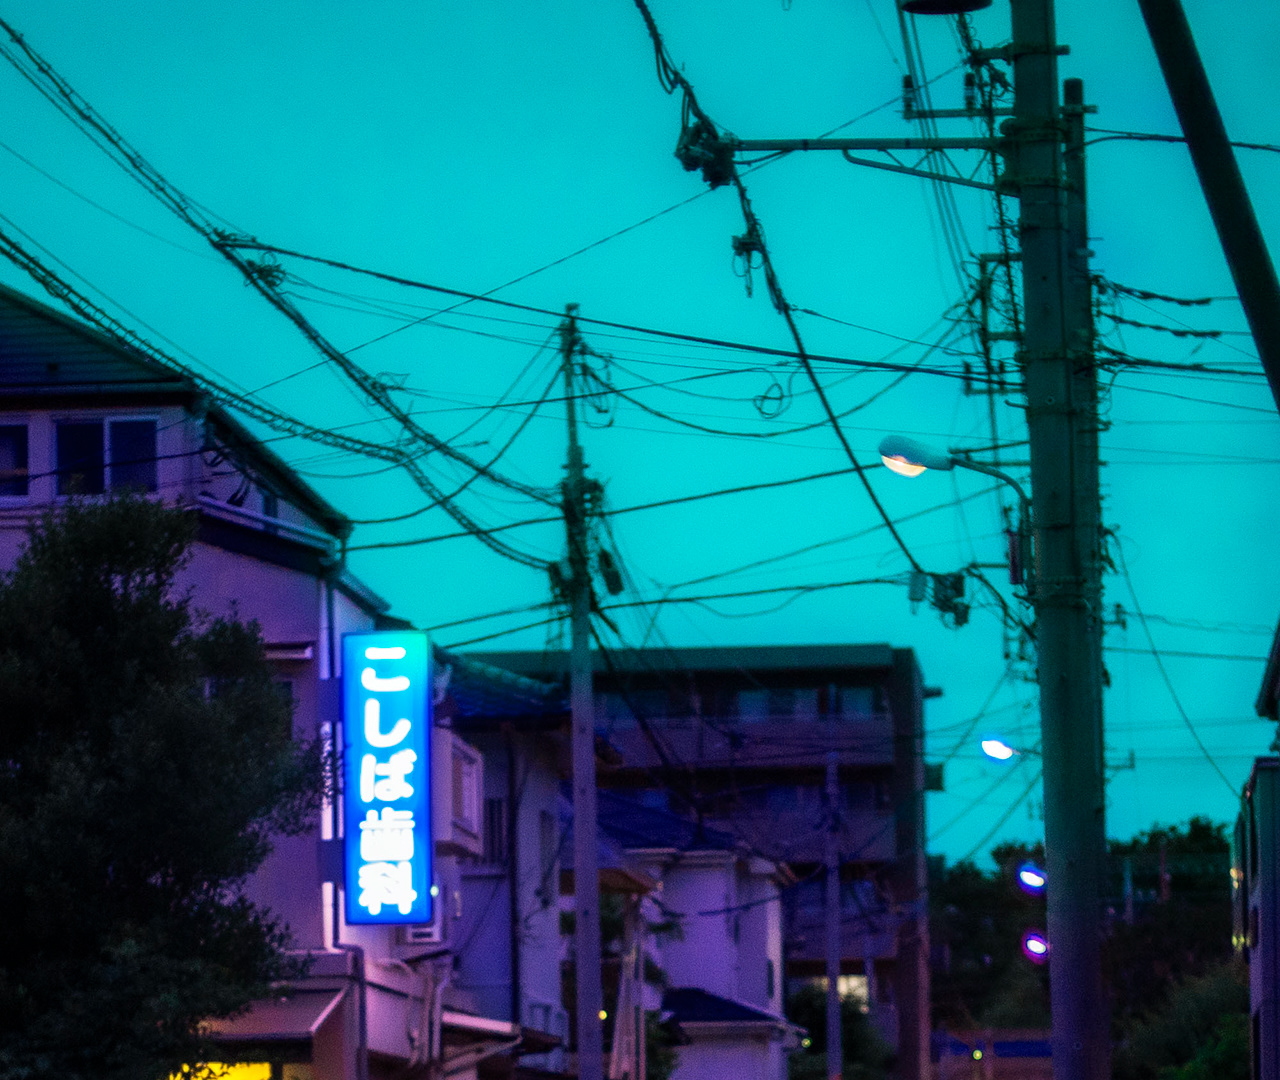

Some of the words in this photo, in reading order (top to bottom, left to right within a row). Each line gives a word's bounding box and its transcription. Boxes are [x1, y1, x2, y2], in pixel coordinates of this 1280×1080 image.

[358, 646, 418, 915] こしば歯科
